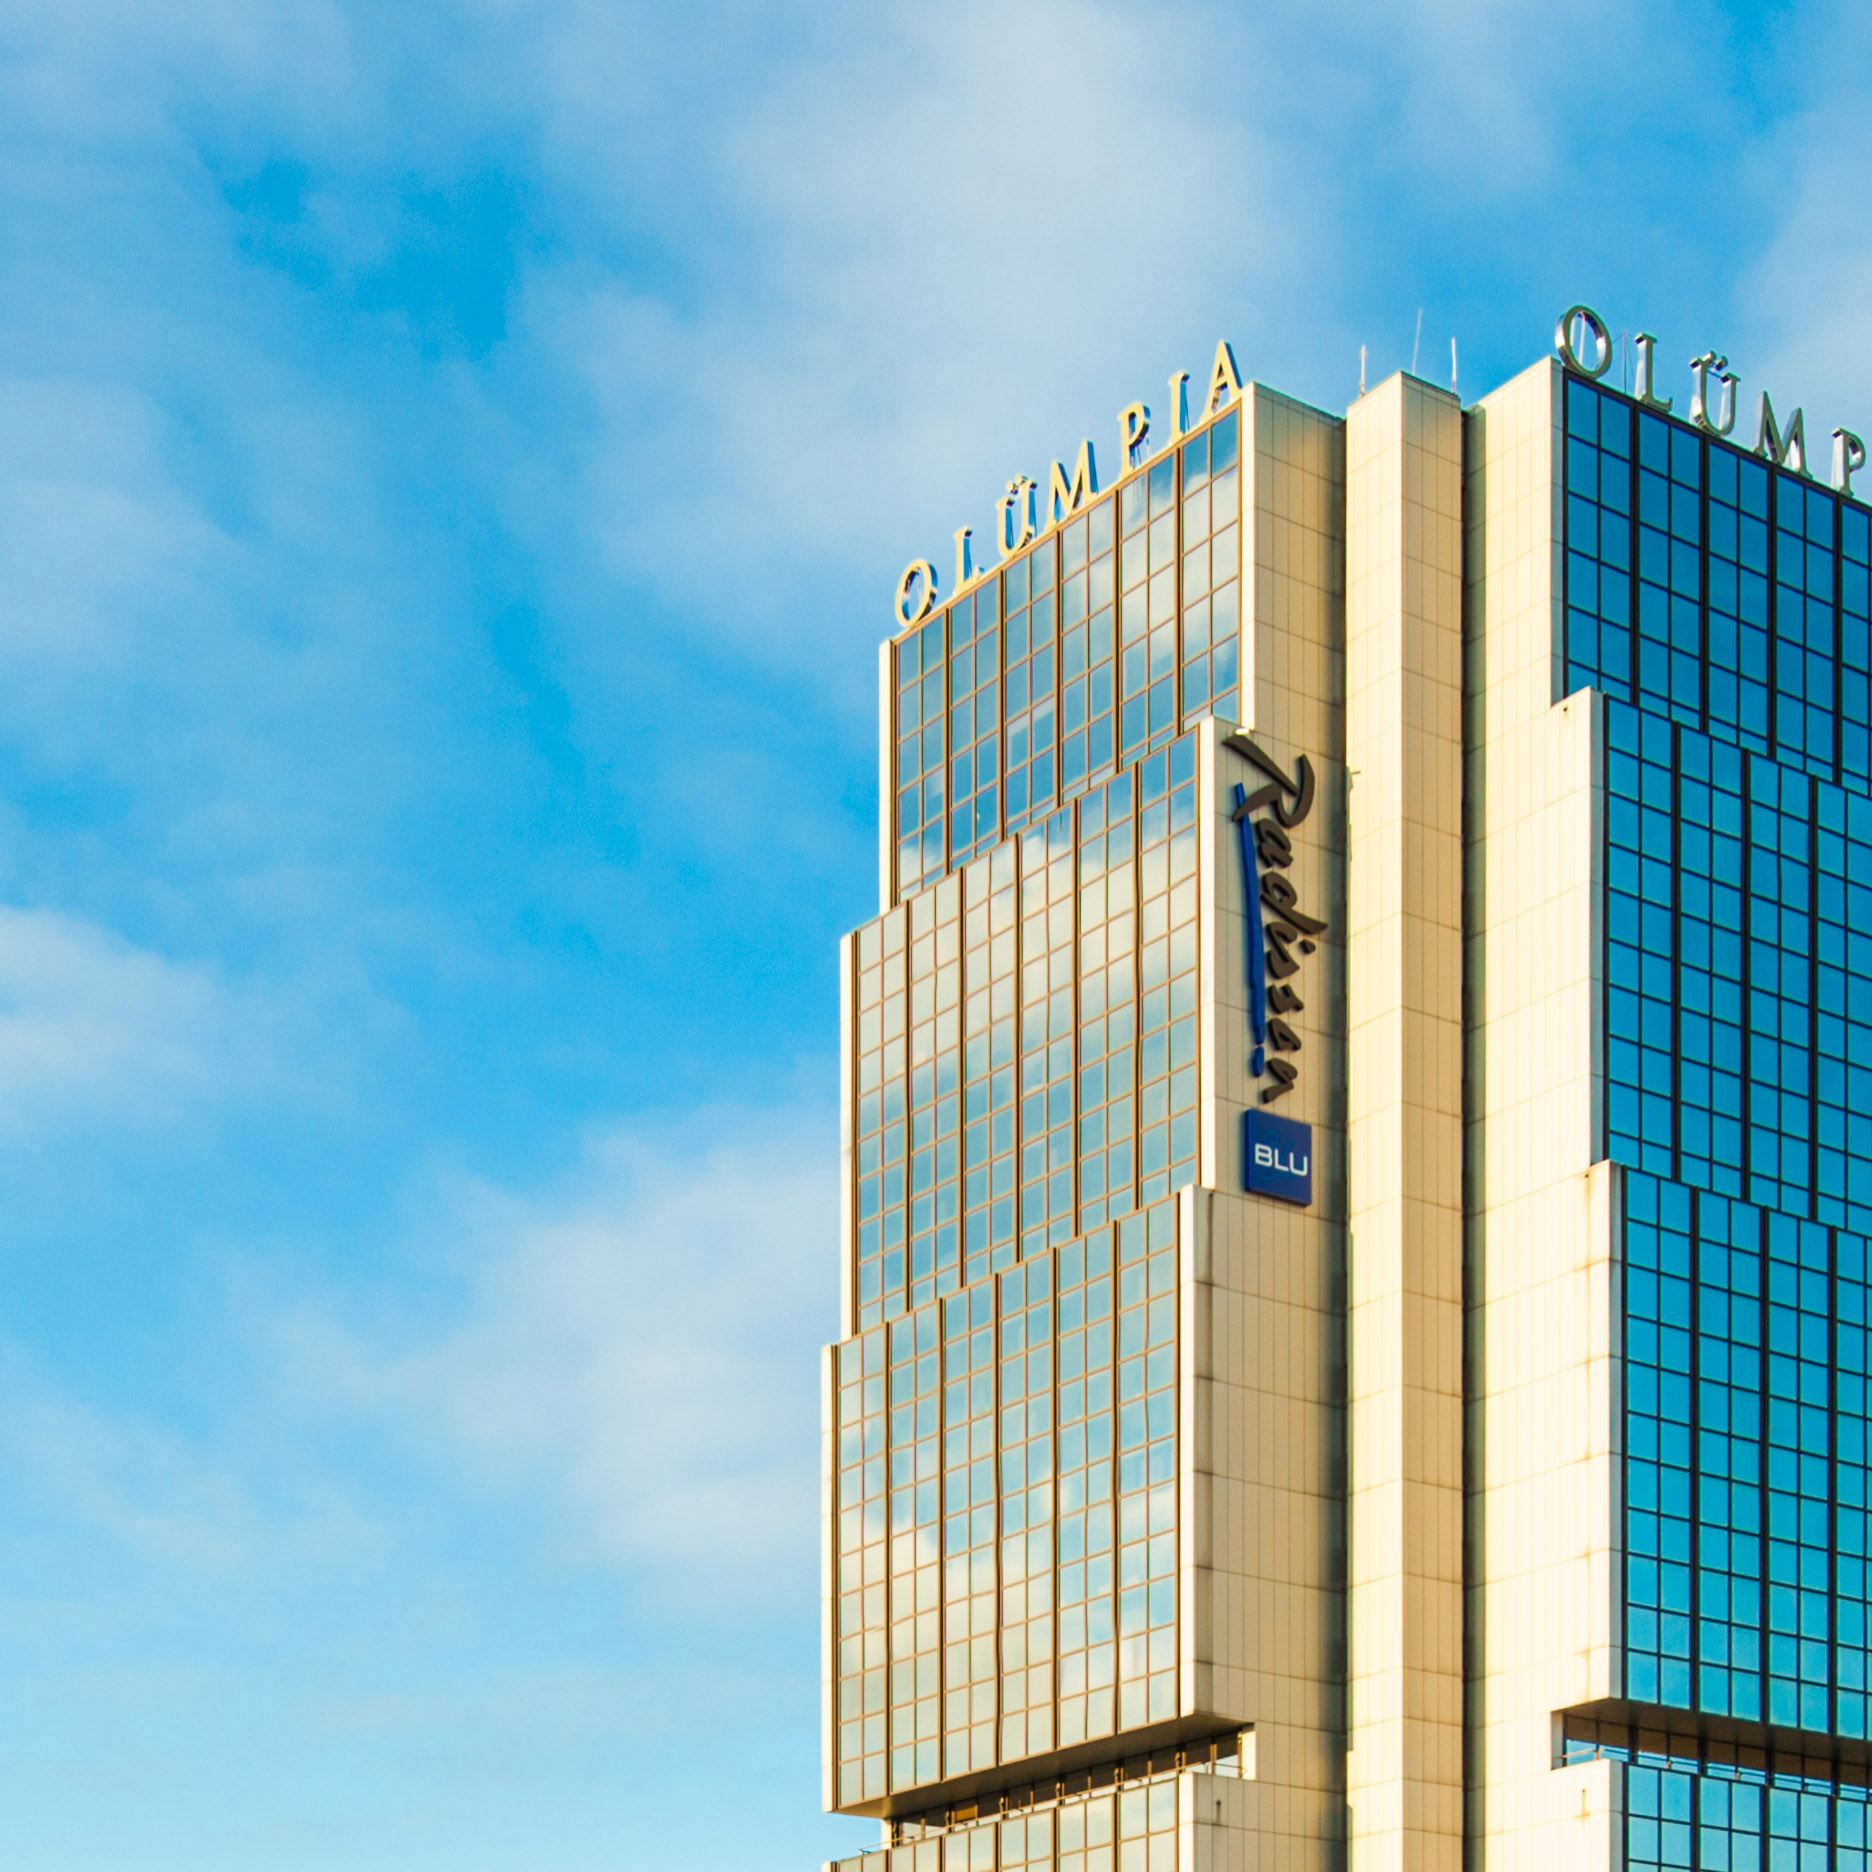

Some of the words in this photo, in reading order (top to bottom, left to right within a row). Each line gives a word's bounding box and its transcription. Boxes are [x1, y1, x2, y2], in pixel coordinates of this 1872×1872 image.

[895, 339, 1243, 628] OLÜMPIA
[1222, 734, 1328, 1104] Radisson
[1254, 1142, 1308, 1177] BLU
